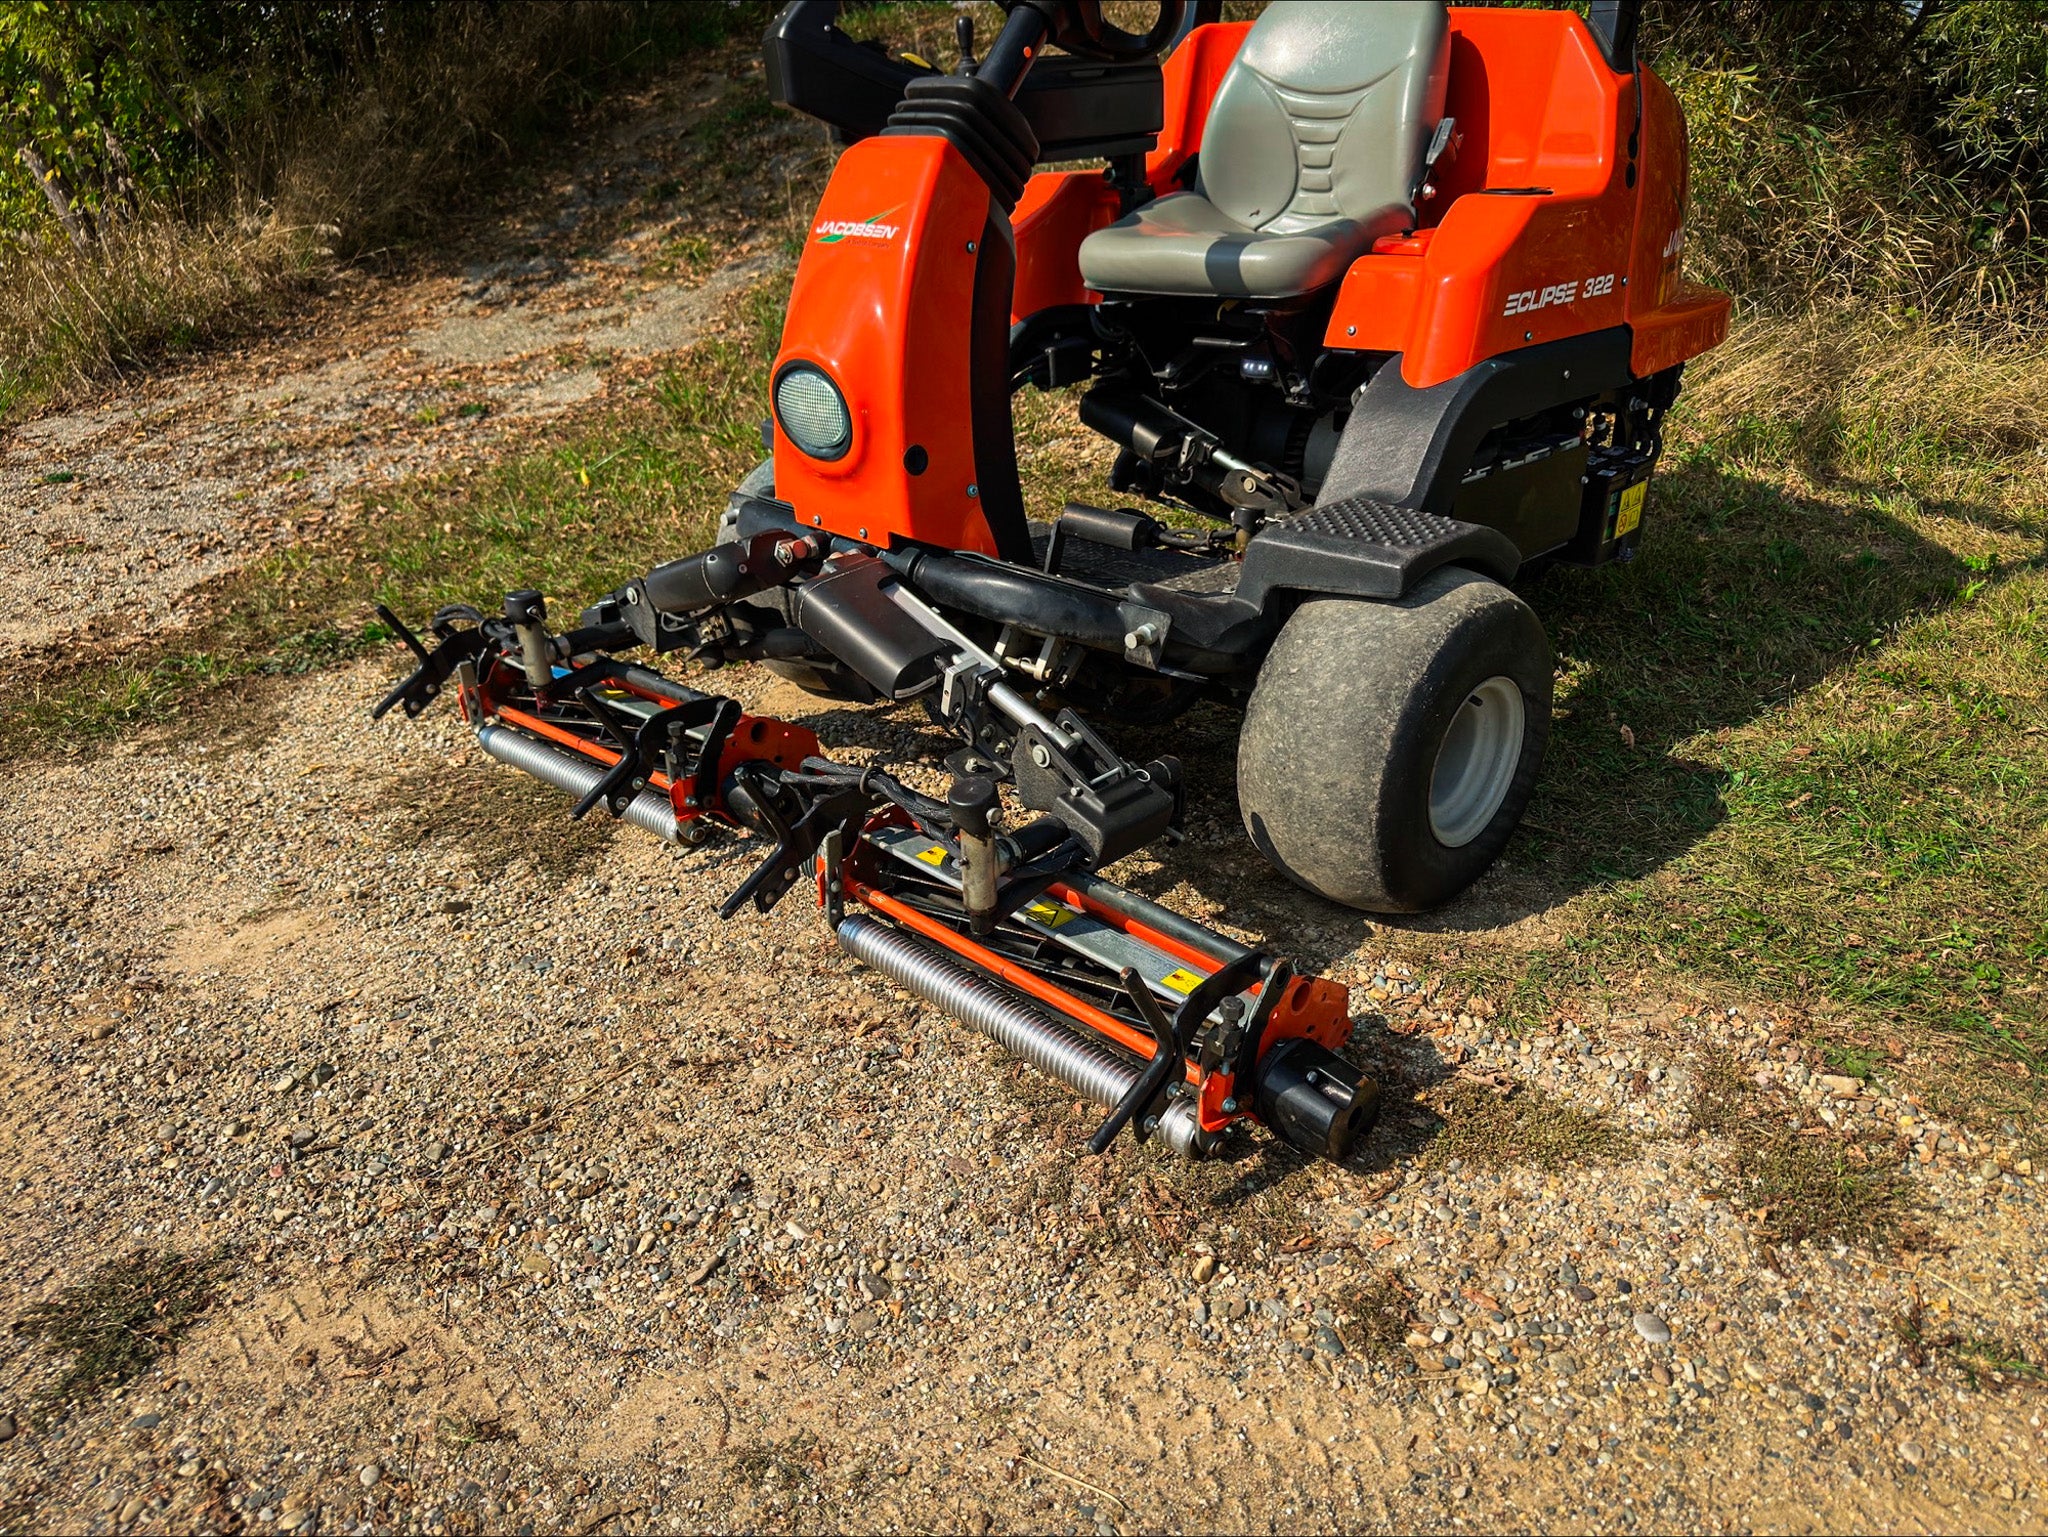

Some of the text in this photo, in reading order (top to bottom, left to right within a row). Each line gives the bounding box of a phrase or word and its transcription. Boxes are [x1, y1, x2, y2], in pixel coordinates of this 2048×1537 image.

[816, 221, 898, 239] JACOBSEN
[1503, 274, 1614, 316] ECLIPSE 322
